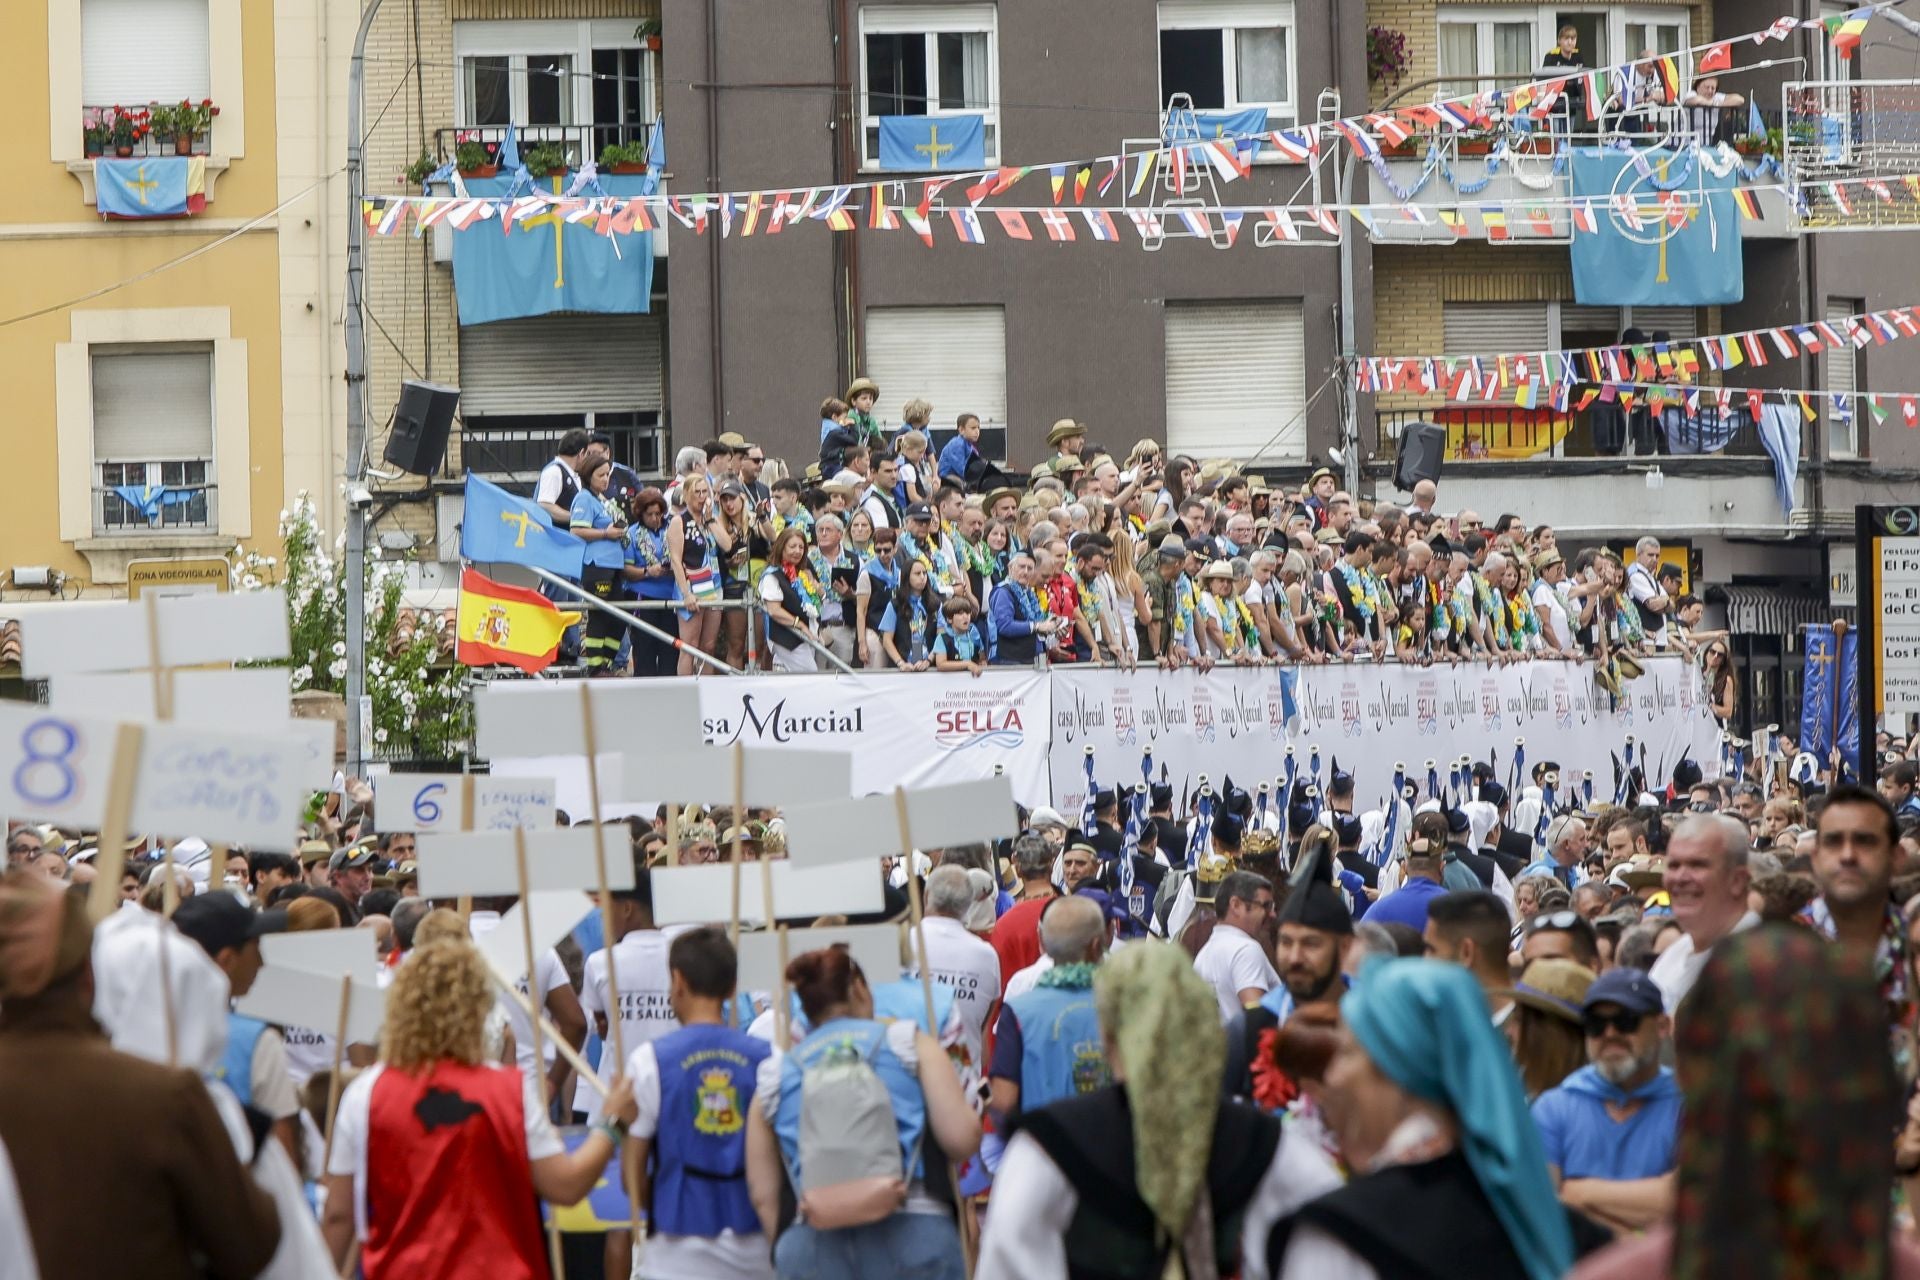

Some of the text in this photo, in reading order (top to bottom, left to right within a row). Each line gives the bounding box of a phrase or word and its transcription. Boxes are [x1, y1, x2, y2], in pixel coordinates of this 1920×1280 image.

[133, 567, 223, 581] ZONA VIDEOVIGILADA
[1884, 560, 1919, 571] El Fo
[1905, 587, 1918, 599] El
[1884, 604, 1906, 615] del
[1885, 647, 1909, 659] Los
[1368, 702, 1381, 718] casa
[1376, 680, 1409, 732] Marcial
[1507, 698, 1521, 713] casa
[1516, 676, 1549, 727] Marcial
[1885, 691, 1920, 702] El Ton
[727, 694, 864, 746] Marcial
[1058, 711, 1073, 727] casa
[1066, 687, 1105, 743] Marcial
[1113, 706, 1135, 728] SELLA
[1142, 709, 1156, 725] casa
[1150, 685, 1187, 741] Marcial
[1193, 703, 1215, 726] SELLA
[1268, 702, 1282, 724] SELL
[1342, 700, 1360, 721] SELLA
[1417, 698, 1436, 720] SELLA
[936, 708, 1023, 733] SELLA
[12, 716, 80, 808] 8
[413, 783, 445, 822] 6
[637, 1010, 678, 1020] SALID
[285, 1034, 325, 1045] ALIDA
